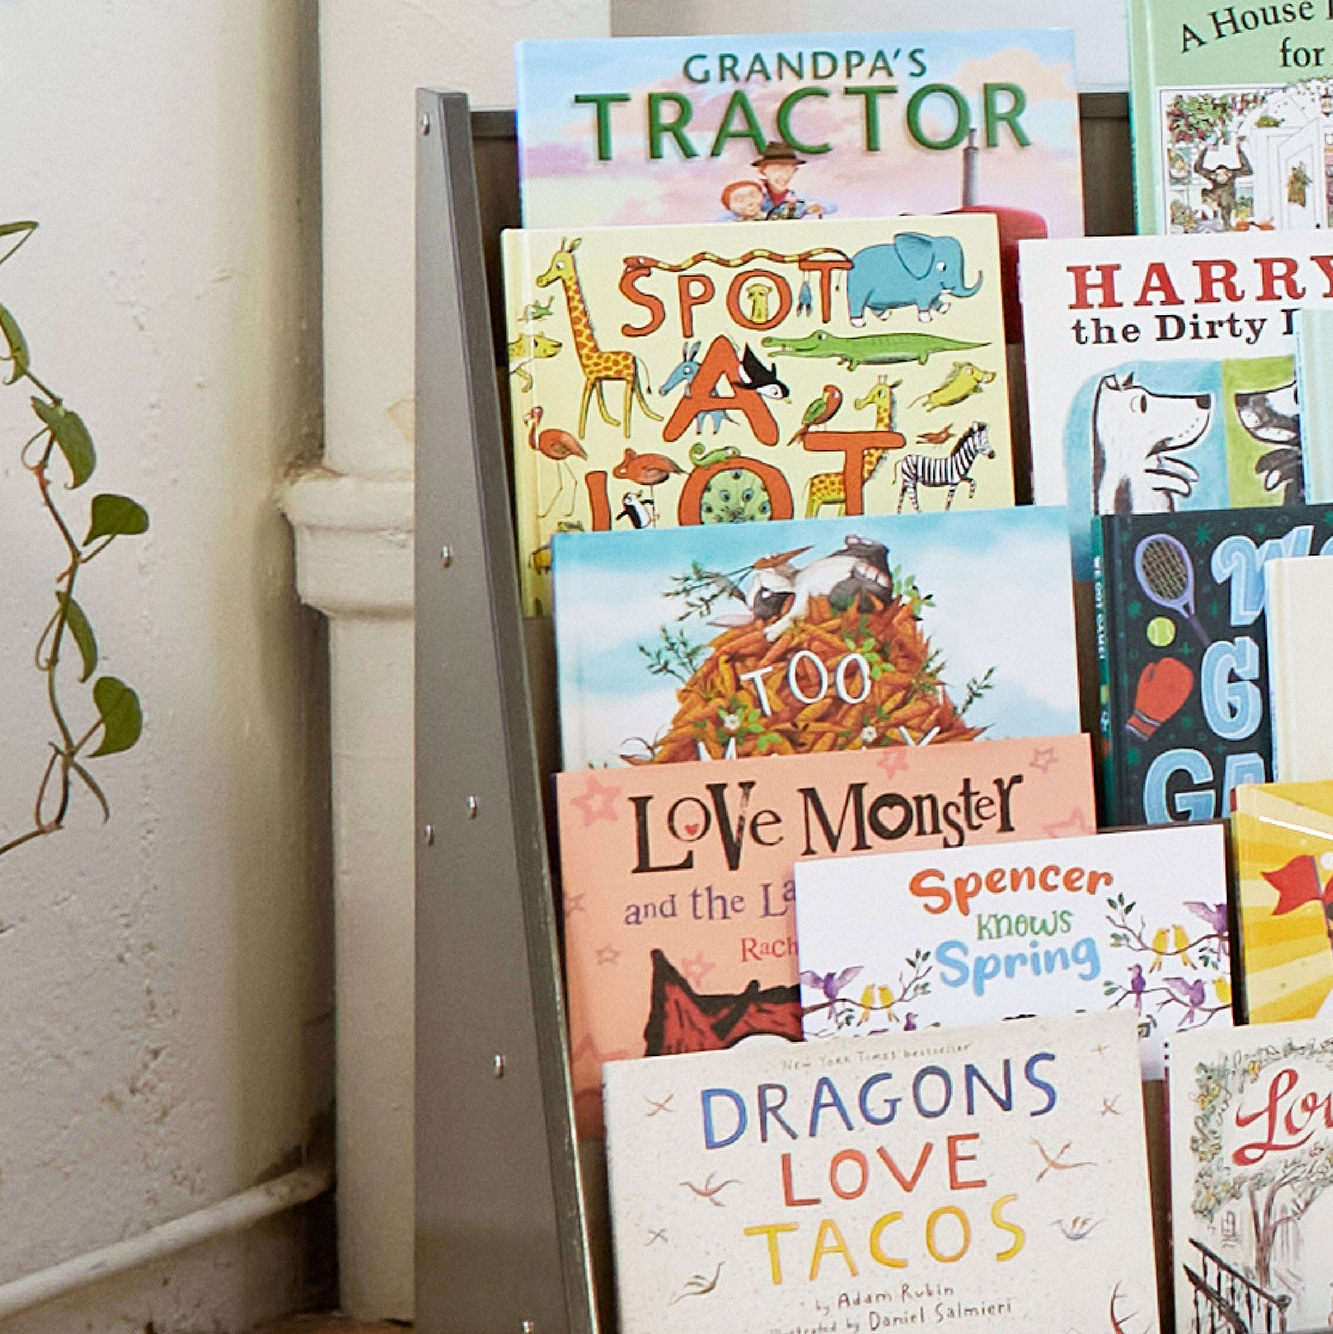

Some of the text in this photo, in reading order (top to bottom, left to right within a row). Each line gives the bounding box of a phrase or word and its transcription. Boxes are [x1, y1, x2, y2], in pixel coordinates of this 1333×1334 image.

[682, 47, 928, 84] GRANDPA'S
[1179, 23, 1207, 54] A
[1279, 37, 1325, 68] for
[574, 82, 1033, 161] TRACTOR
[618, 259, 855, 338] SPOT
[1071, 317, 1142, 345] the
[1154, 312, 1268, 345] Dirty
[662, 335, 780, 446] A
[740, 649, 872, 717] TOO
[797, 773, 1024, 857] Monster
[624, 880, 796, 925] and the La
[909, 864, 1113, 916] Spencer
[741, 936, 799, 963] Rach
[935, 937, 1102, 996] Spring
[700, 1051, 1058, 1149] DRAGONS
[780, 1133, 988, 1208] LOVE
[744, 1194, 1026, 1285] TACOS
[815, 1283, 954, 1315] by Adam Rubin
[869, 1307, 924, 1331] Daniel
[935, 1298, 1011, 1323] Salmieri
